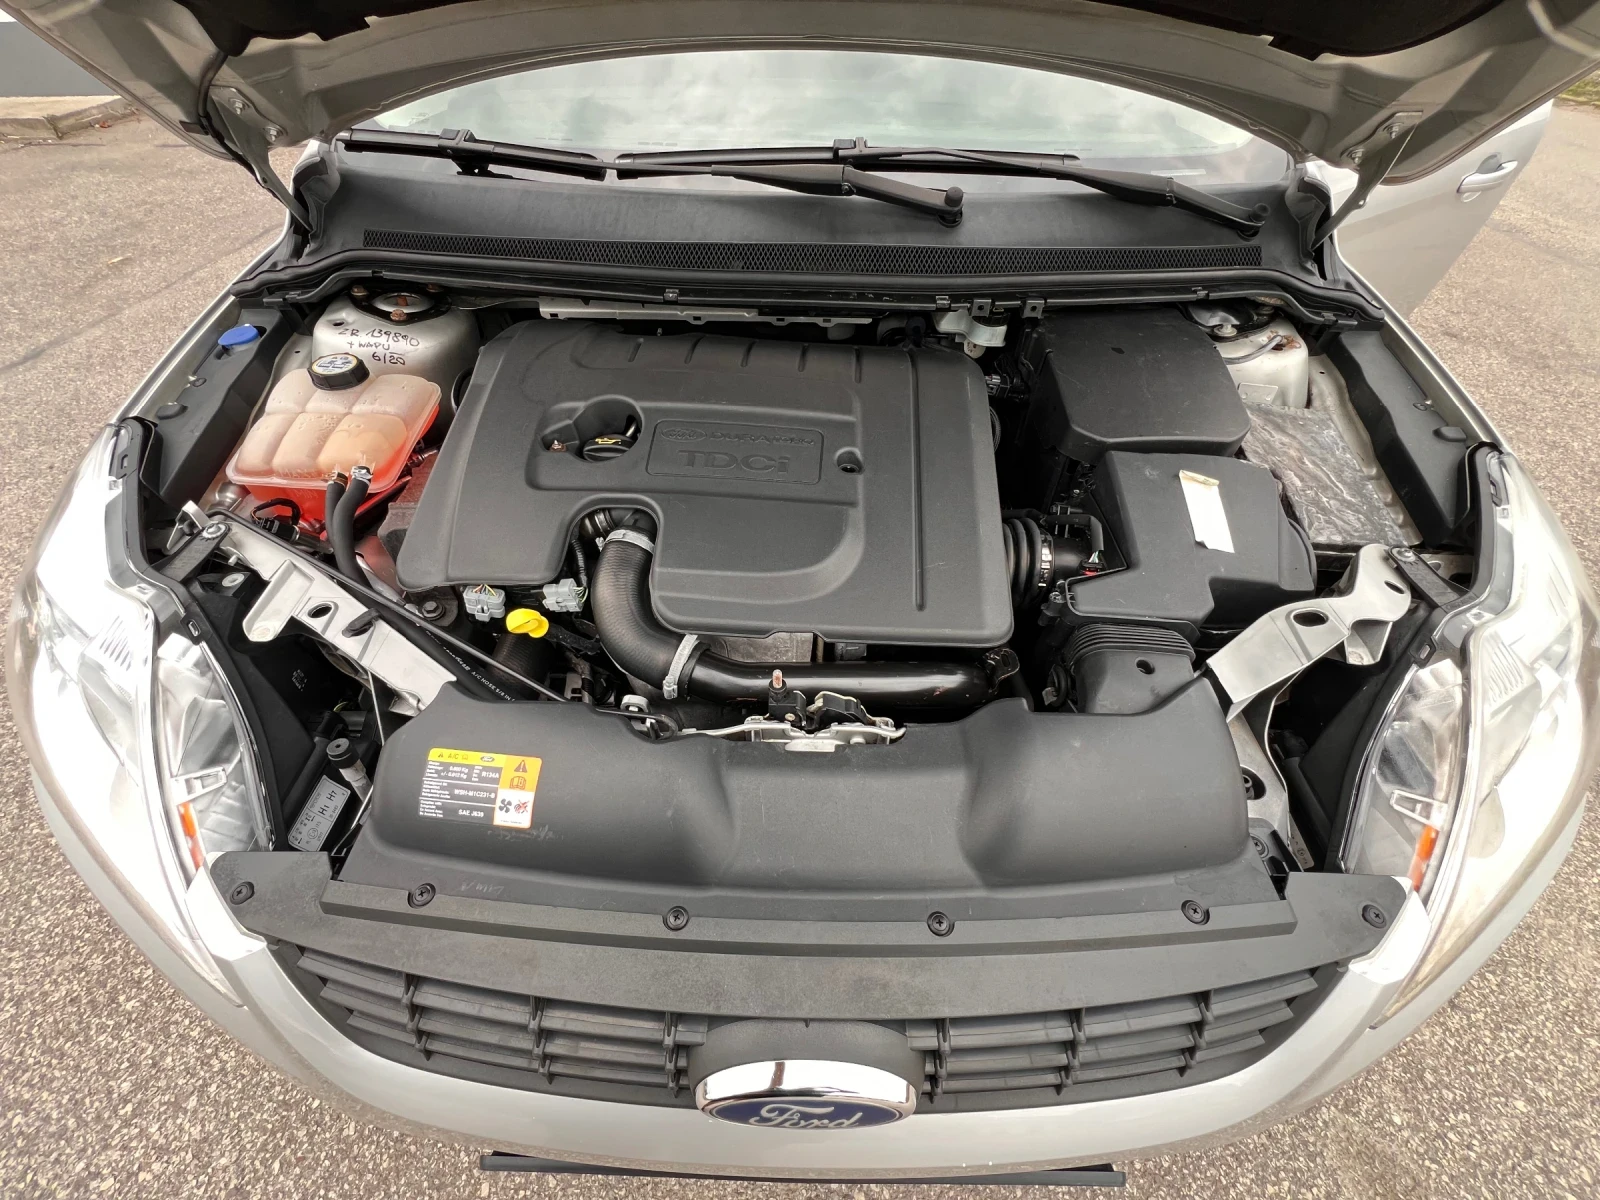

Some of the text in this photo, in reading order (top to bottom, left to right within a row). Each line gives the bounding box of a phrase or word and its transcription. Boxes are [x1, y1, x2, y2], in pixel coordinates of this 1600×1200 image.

[366, 328, 420, 347] 139890
[678, 449, 791, 475] TDCi
[481, 771, 500, 779] R134A
[748, 1104, 863, 1129] Ford
